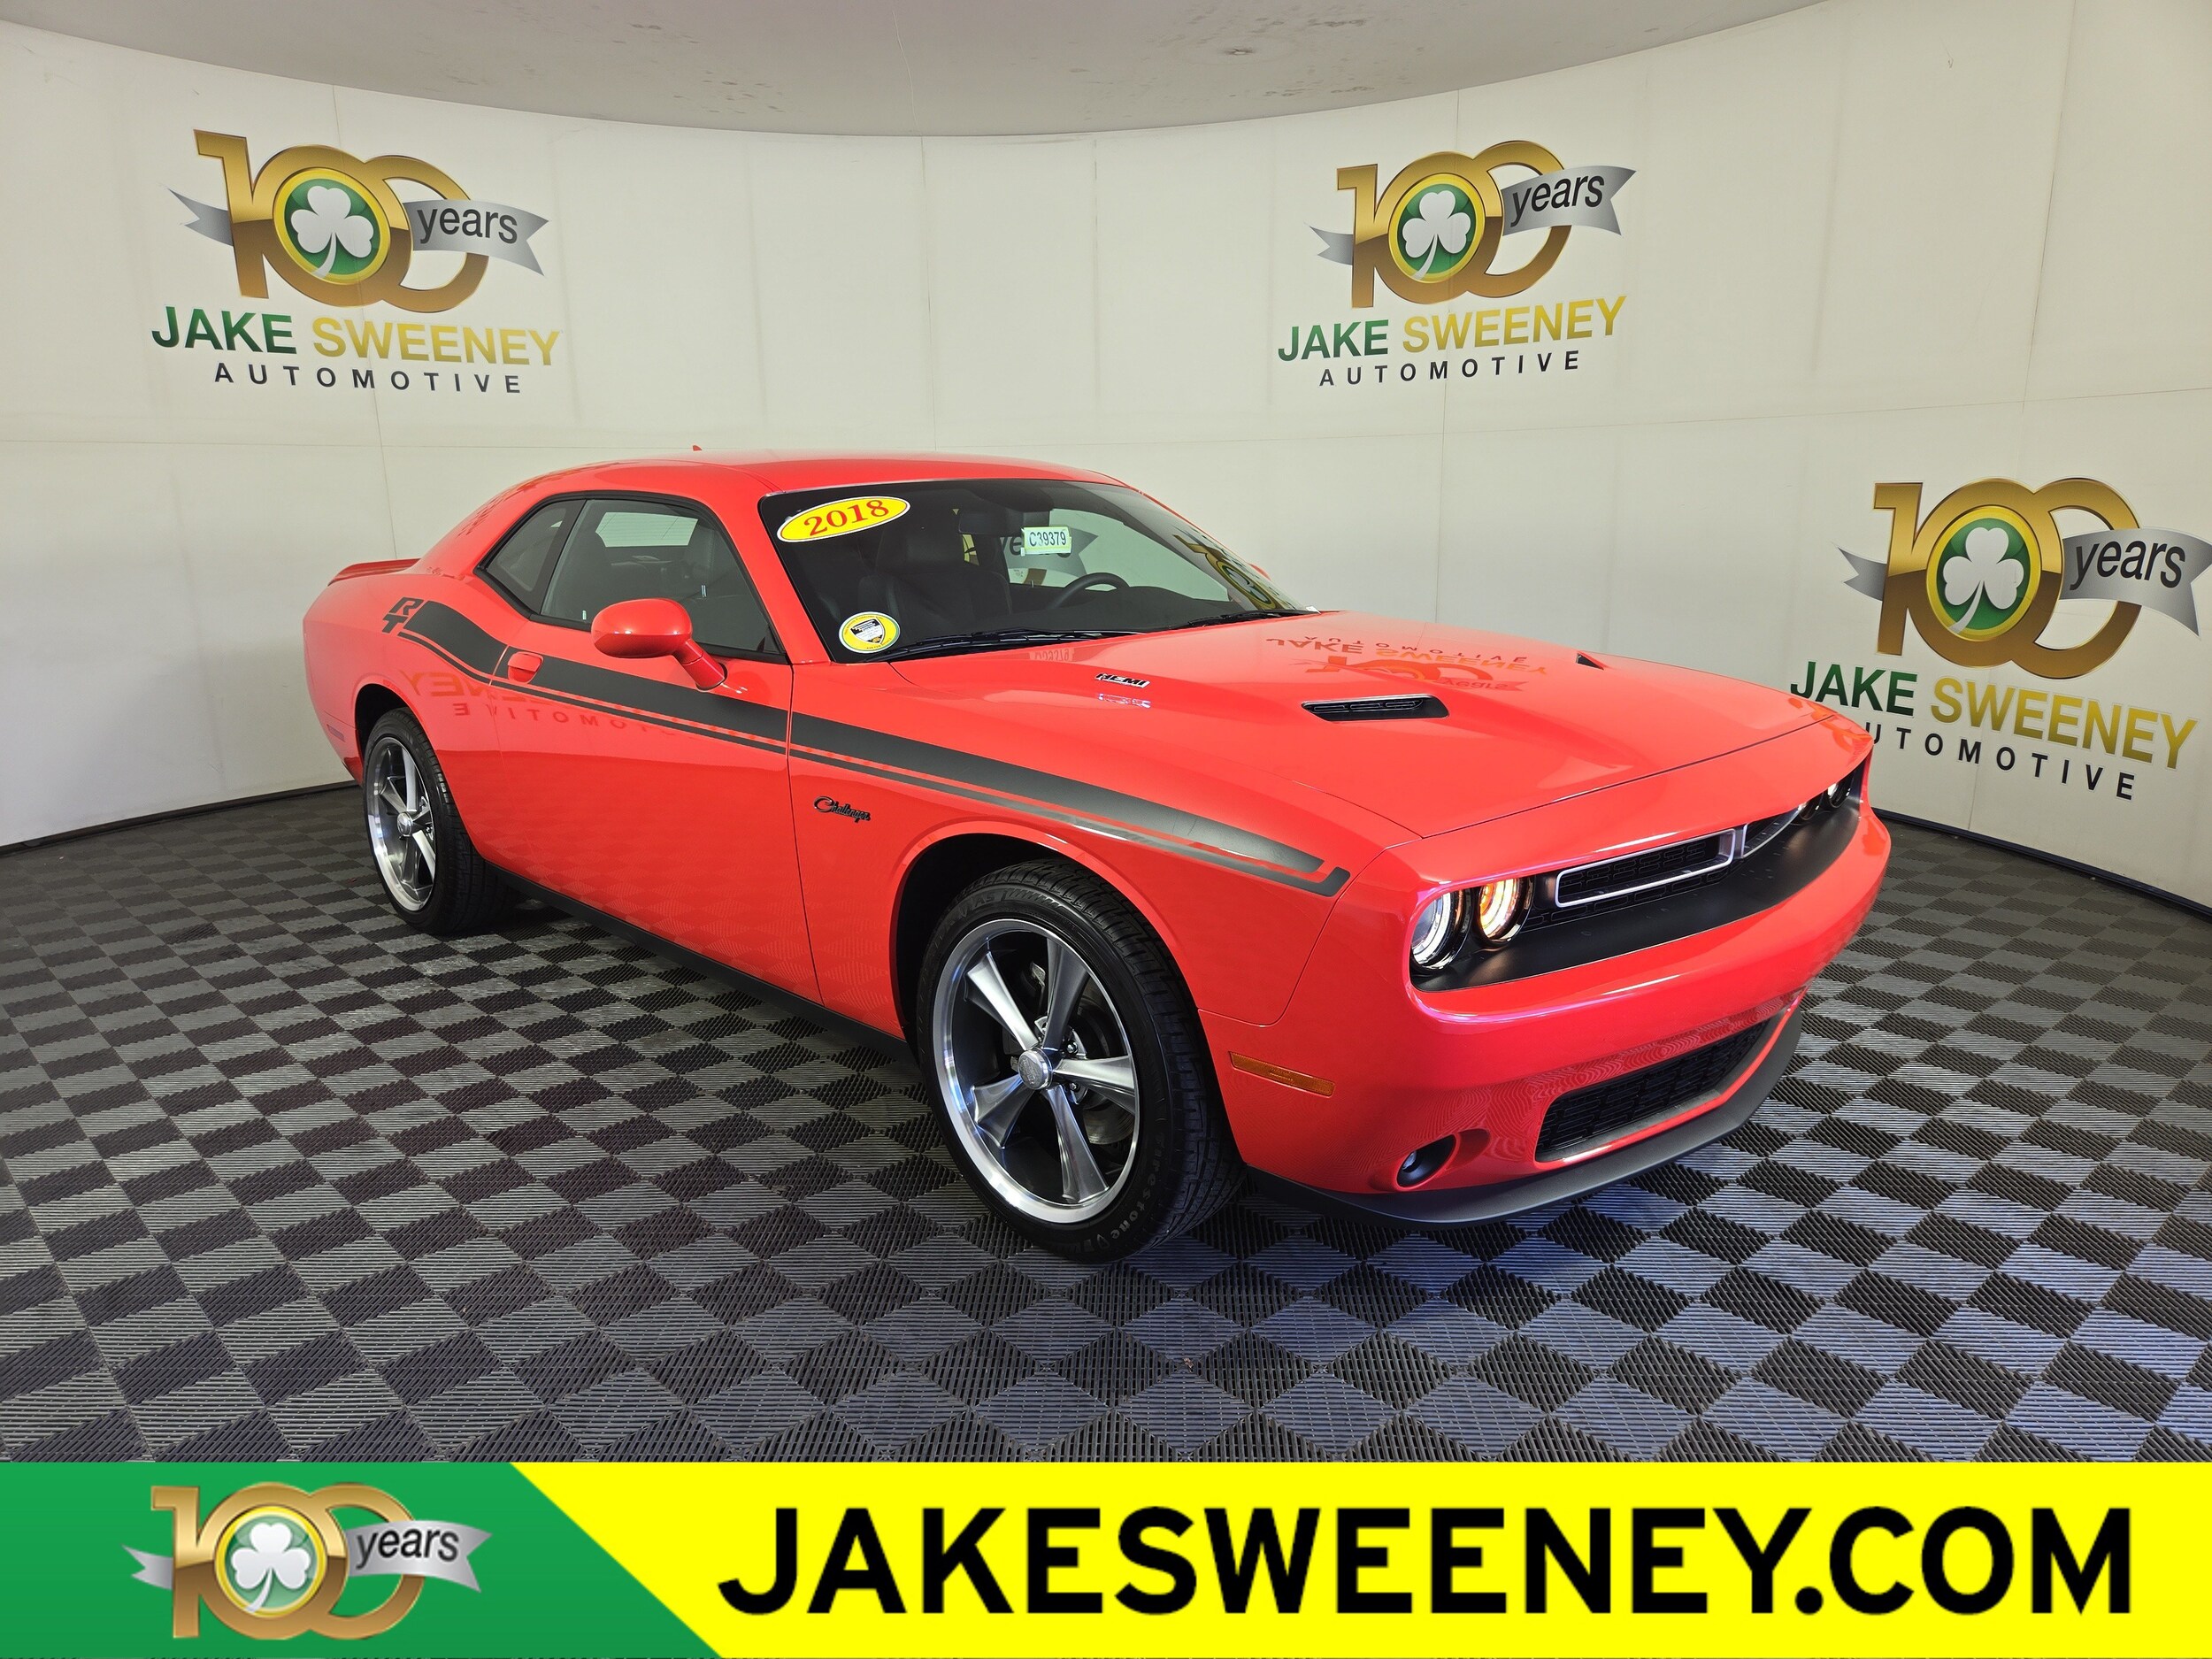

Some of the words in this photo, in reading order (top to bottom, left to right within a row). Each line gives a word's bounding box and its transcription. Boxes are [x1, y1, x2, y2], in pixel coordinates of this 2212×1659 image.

[1510, 174, 1604, 227] years
[417, 206, 518, 244] years
[151, 306, 297, 354] JAKE
[312, 317, 560, 366] SWEENEY
[1278, 319, 1389, 362] JAKE
[1402, 296, 1627, 353] SWEENEY
[215, 362, 520, 394] AUTOMOTIVE
[1319, 350, 1579, 387] AUTOMOTIVE
[803, 500, 889, 536] 2018
[1029, 531, 1067, 547] C39379
[2069, 540, 2185, 590] years
[1790, 660, 1917, 717] JAKE
[1931, 678, 2197, 770] SWEENEY
[1865, 721, 2135, 801] UTOMOTIVE
[813, 795, 872, 824] Challenger
